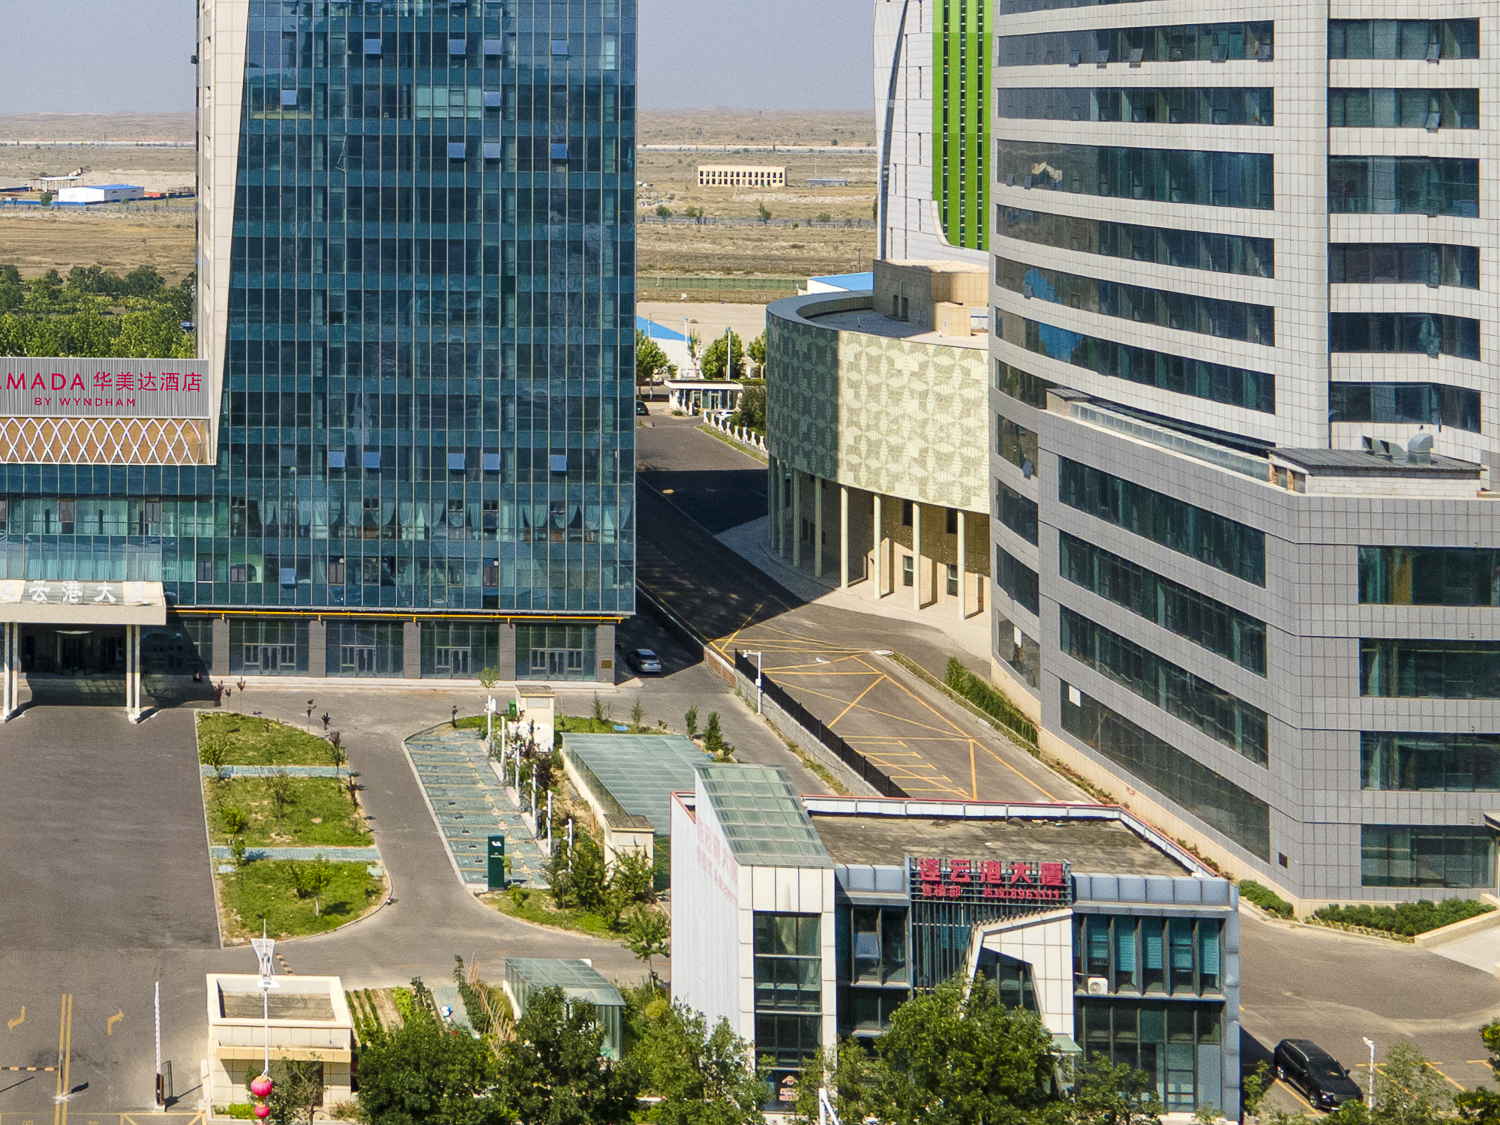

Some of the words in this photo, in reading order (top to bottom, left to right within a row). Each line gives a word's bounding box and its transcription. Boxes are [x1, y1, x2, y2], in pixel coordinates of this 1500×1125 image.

[93, 371, 202, 392] 华美达酒店
[35, 397, 52, 406] BY
[60, 397, 136, 407] WYNDHAM
[919, 857, 1063, 887] 连云港大厦
[921, 883, 961, 898] 售楼部
